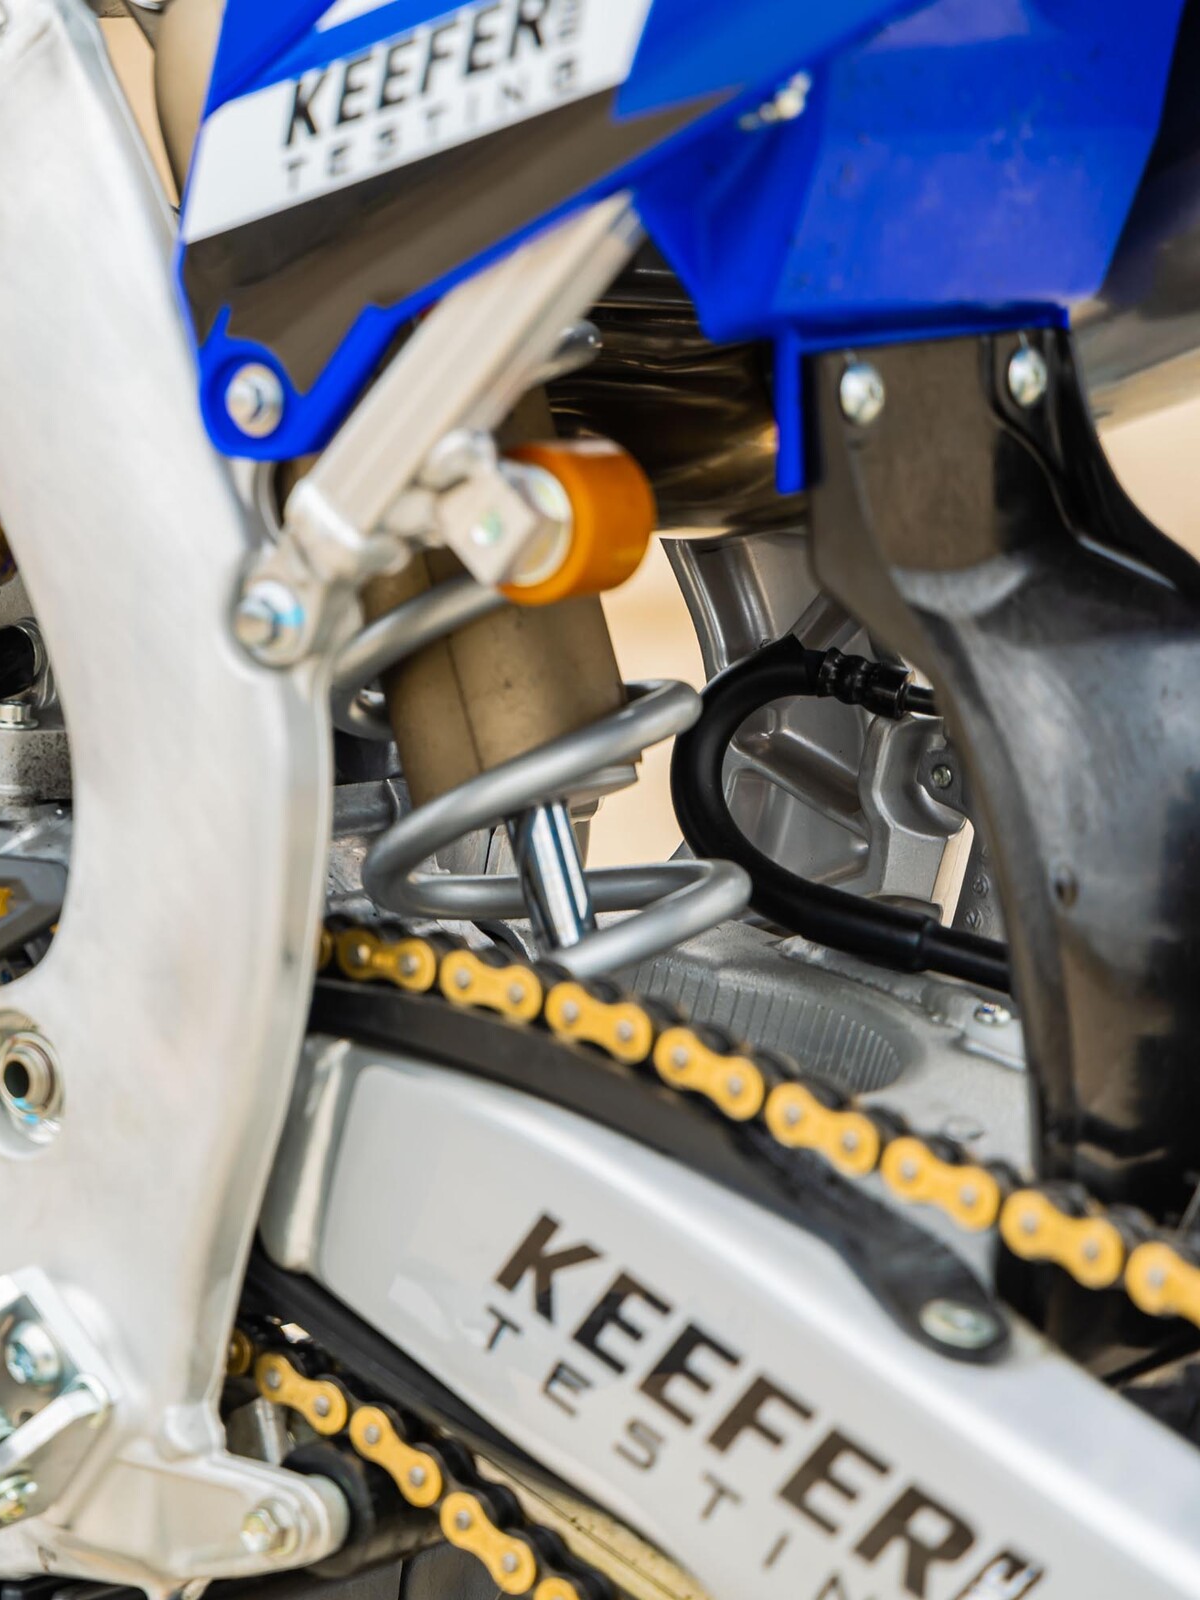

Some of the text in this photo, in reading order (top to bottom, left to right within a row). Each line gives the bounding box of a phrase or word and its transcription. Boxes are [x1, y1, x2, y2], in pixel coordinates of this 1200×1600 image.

[283, 56, 577, 192] TESTING
[284, 0, 550, 148] KEEFER
[495, 1212, 976, 1600] KEEFER
